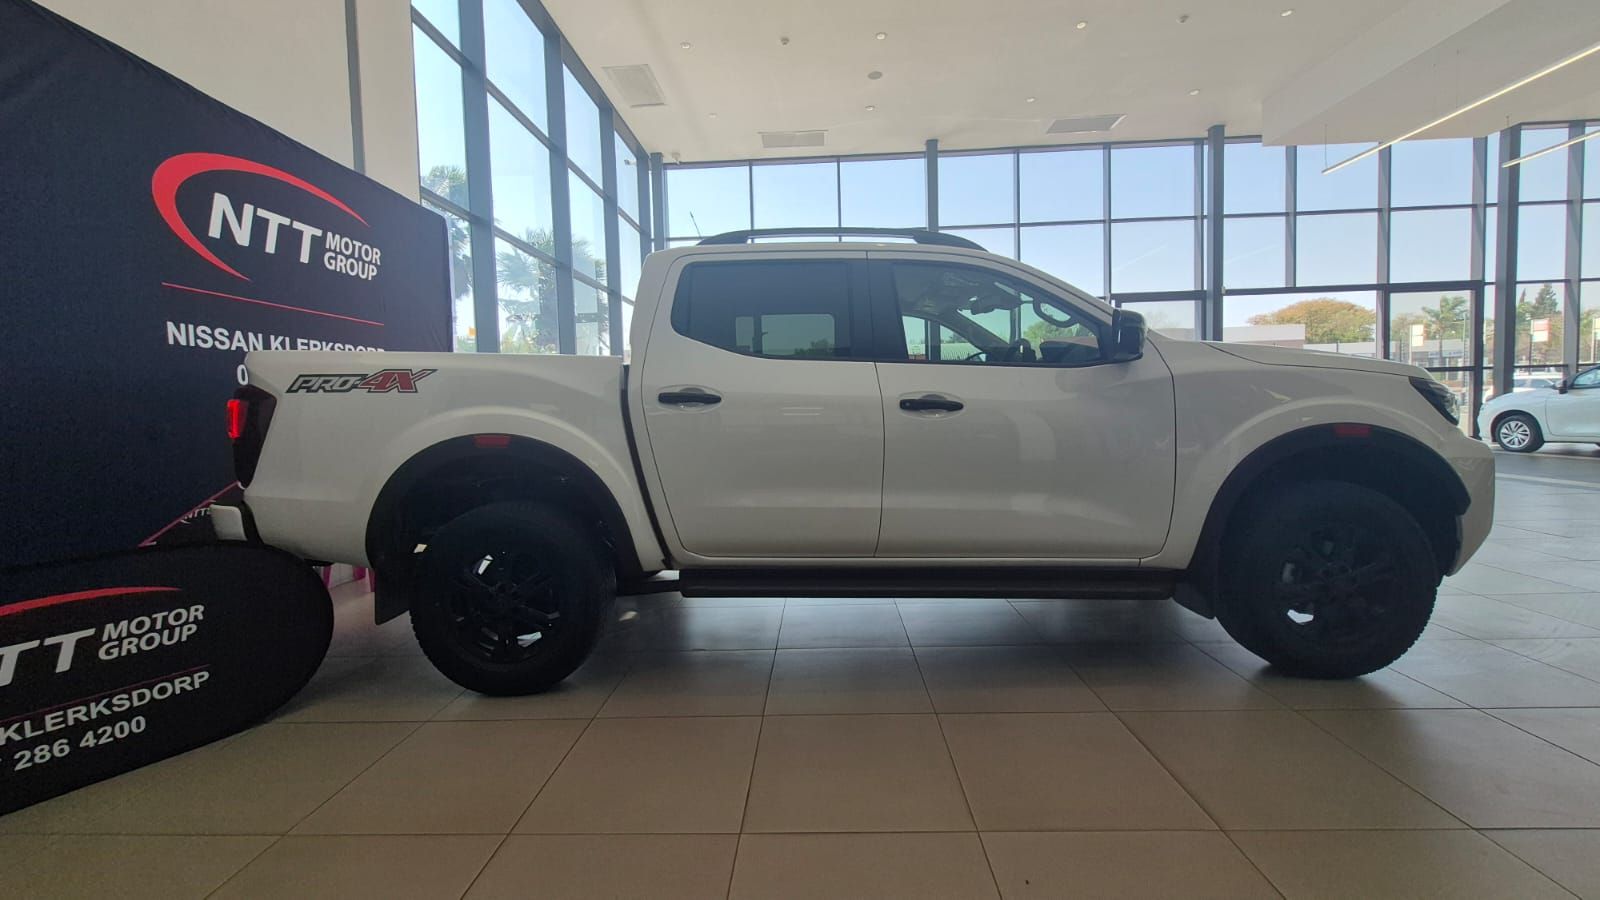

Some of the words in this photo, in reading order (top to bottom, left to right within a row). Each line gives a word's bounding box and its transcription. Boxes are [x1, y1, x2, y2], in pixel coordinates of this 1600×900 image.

[208, 192, 322, 264] NTT
[323, 251, 378, 281] GROUP
[325, 231, 381, 265] MOTOR
[166, 321, 263, 352] NISSAN
[285, 369, 438, 393] PRO-4X
[98, 623, 198, 660] GROUP
[102, 604, 205, 642] MOTOR
[0, 671, 210, 746] KLERKSDORP
[13, 738, 70, 771] 286
[79, 715, 147, 748] 4200
